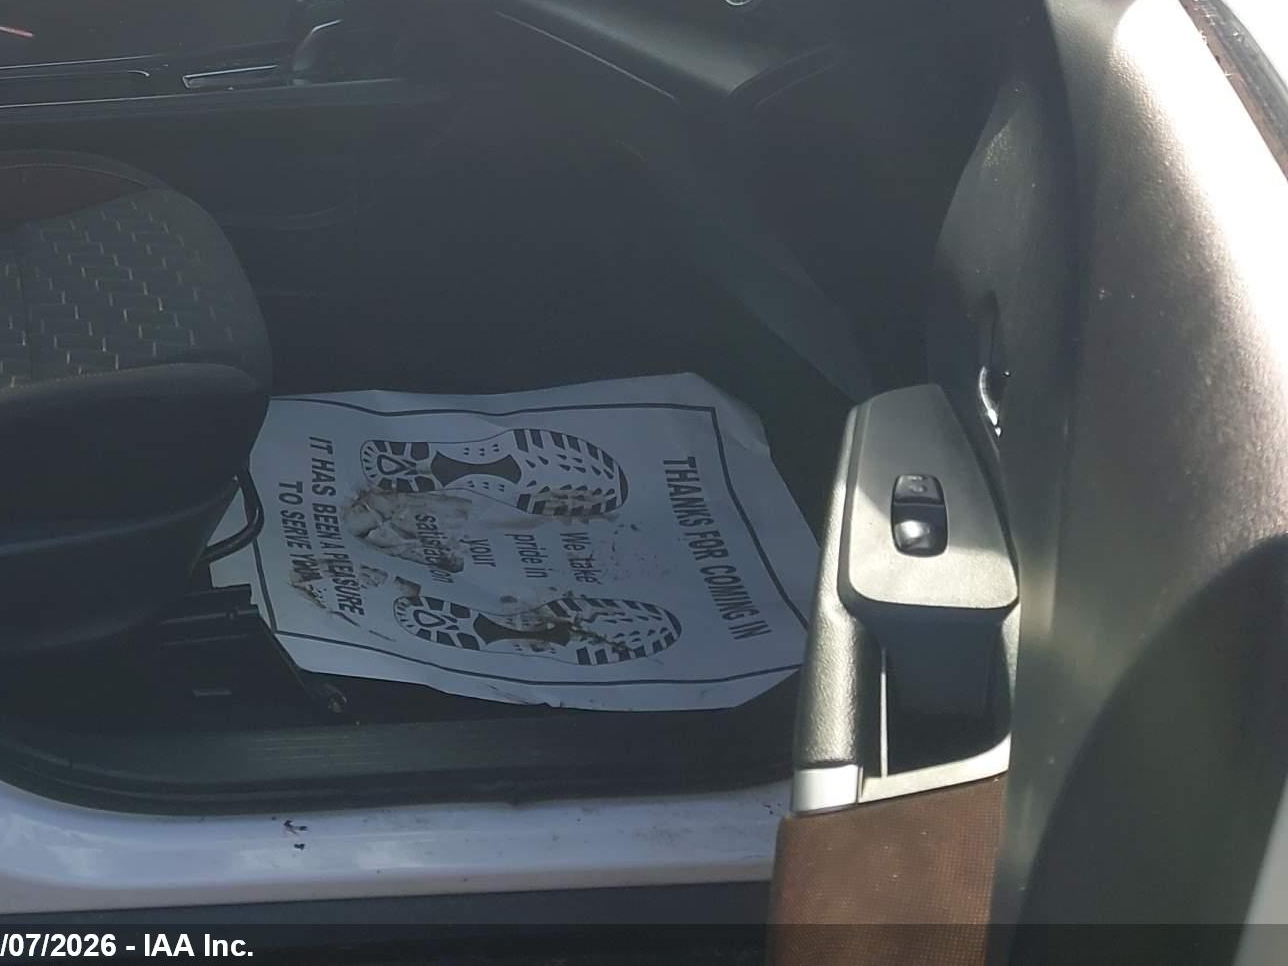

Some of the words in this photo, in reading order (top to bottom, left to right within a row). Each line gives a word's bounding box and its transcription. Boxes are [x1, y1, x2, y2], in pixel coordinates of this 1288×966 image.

[309, 436, 334, 455] IT
[311, 457, 336, 497] HAS
[663, 456, 714, 527] THANKS
[278, 481, 303, 506] TO
[280, 509, 312, 551] SERVE
[312, 502, 343, 540] BEEN
[319, 541, 345, 551] A
[460, 538, 496, 567] your
[504, 533, 549, 564] pride
[559, 532, 591, 551] We
[684, 530, 729, 560] FOR
[524, 567, 553, 579] in
[568, 553, 603, 584] take
[322, 552, 365, 616] PLEASURE
[700, 565, 760, 620] COMING
[728, 620, 773, 640] IN
